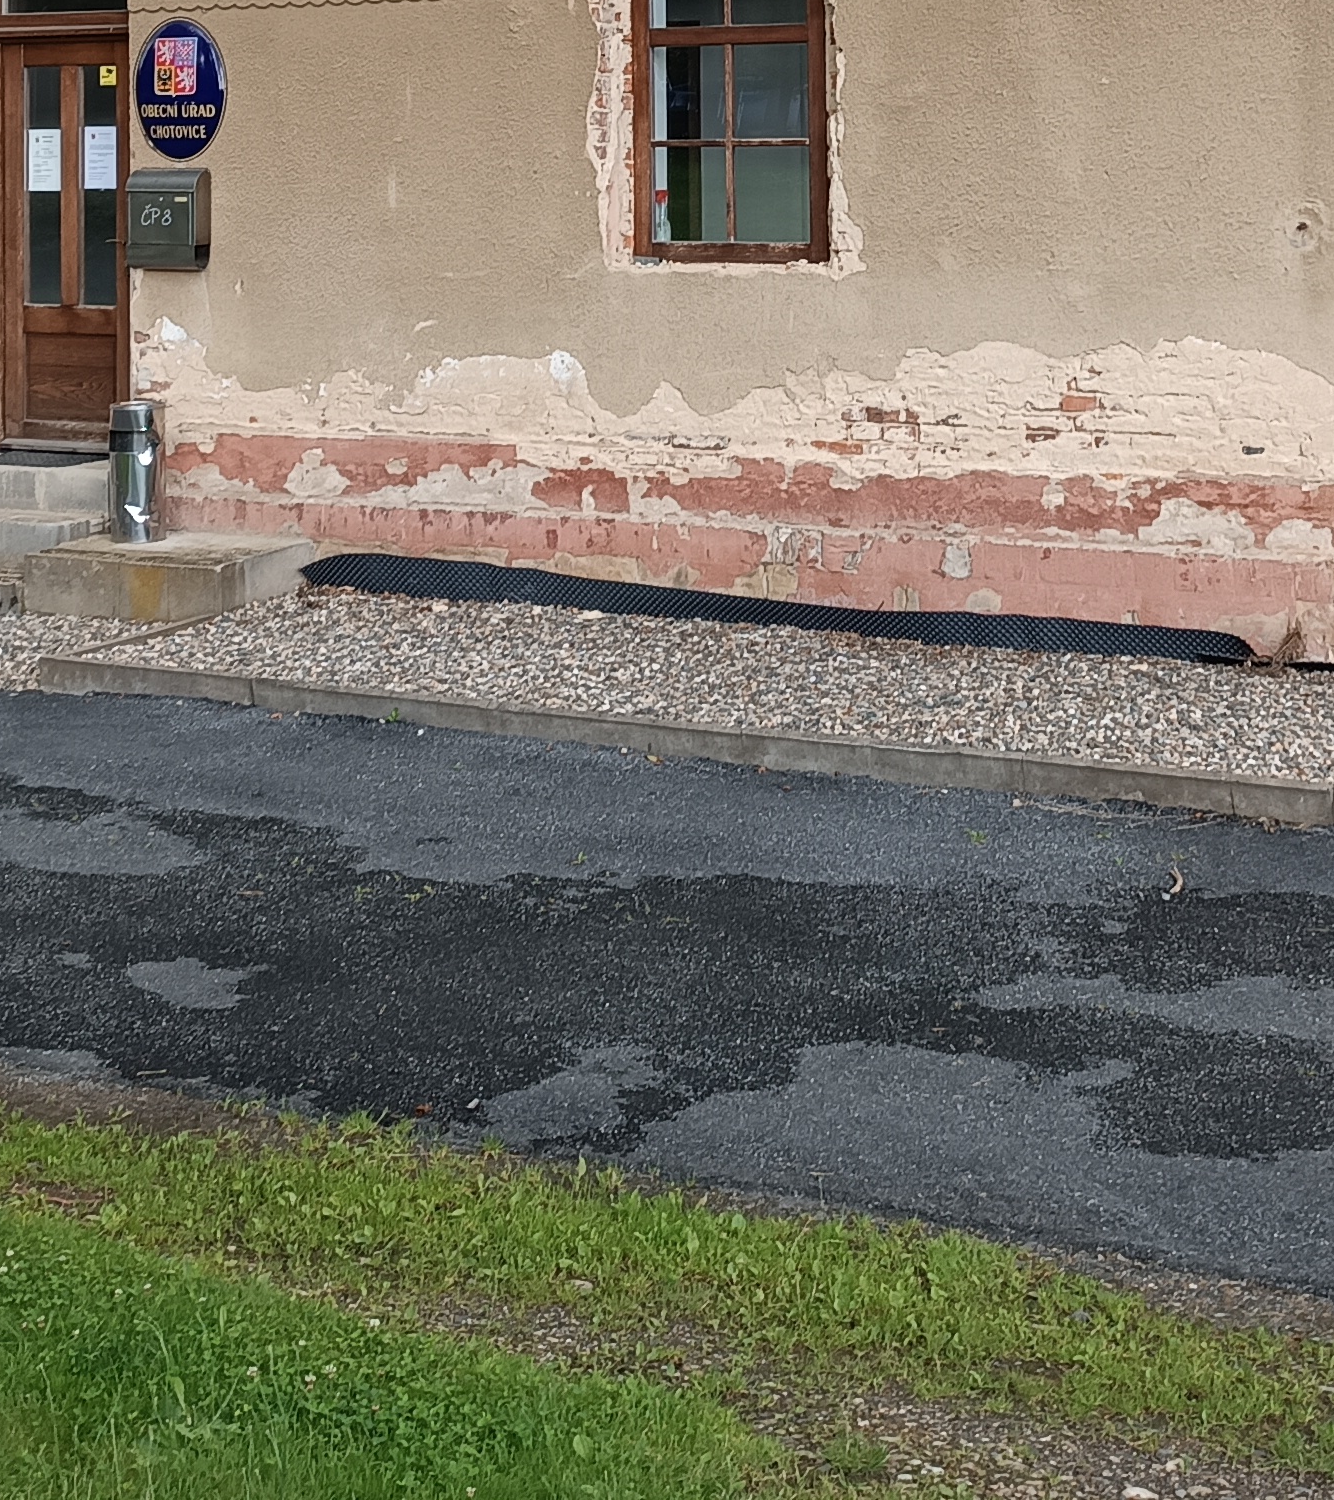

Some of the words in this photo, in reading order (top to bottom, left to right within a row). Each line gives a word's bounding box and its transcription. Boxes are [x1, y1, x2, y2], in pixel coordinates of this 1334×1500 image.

[140, 100, 178, 118] OBECNÍ
[181, 101, 216, 118] ÚŘAD
[150, 124, 207, 139] CHOTOVICE
[140, 203, 161, 226] ČP
[161, 208, 172, 226] 8
